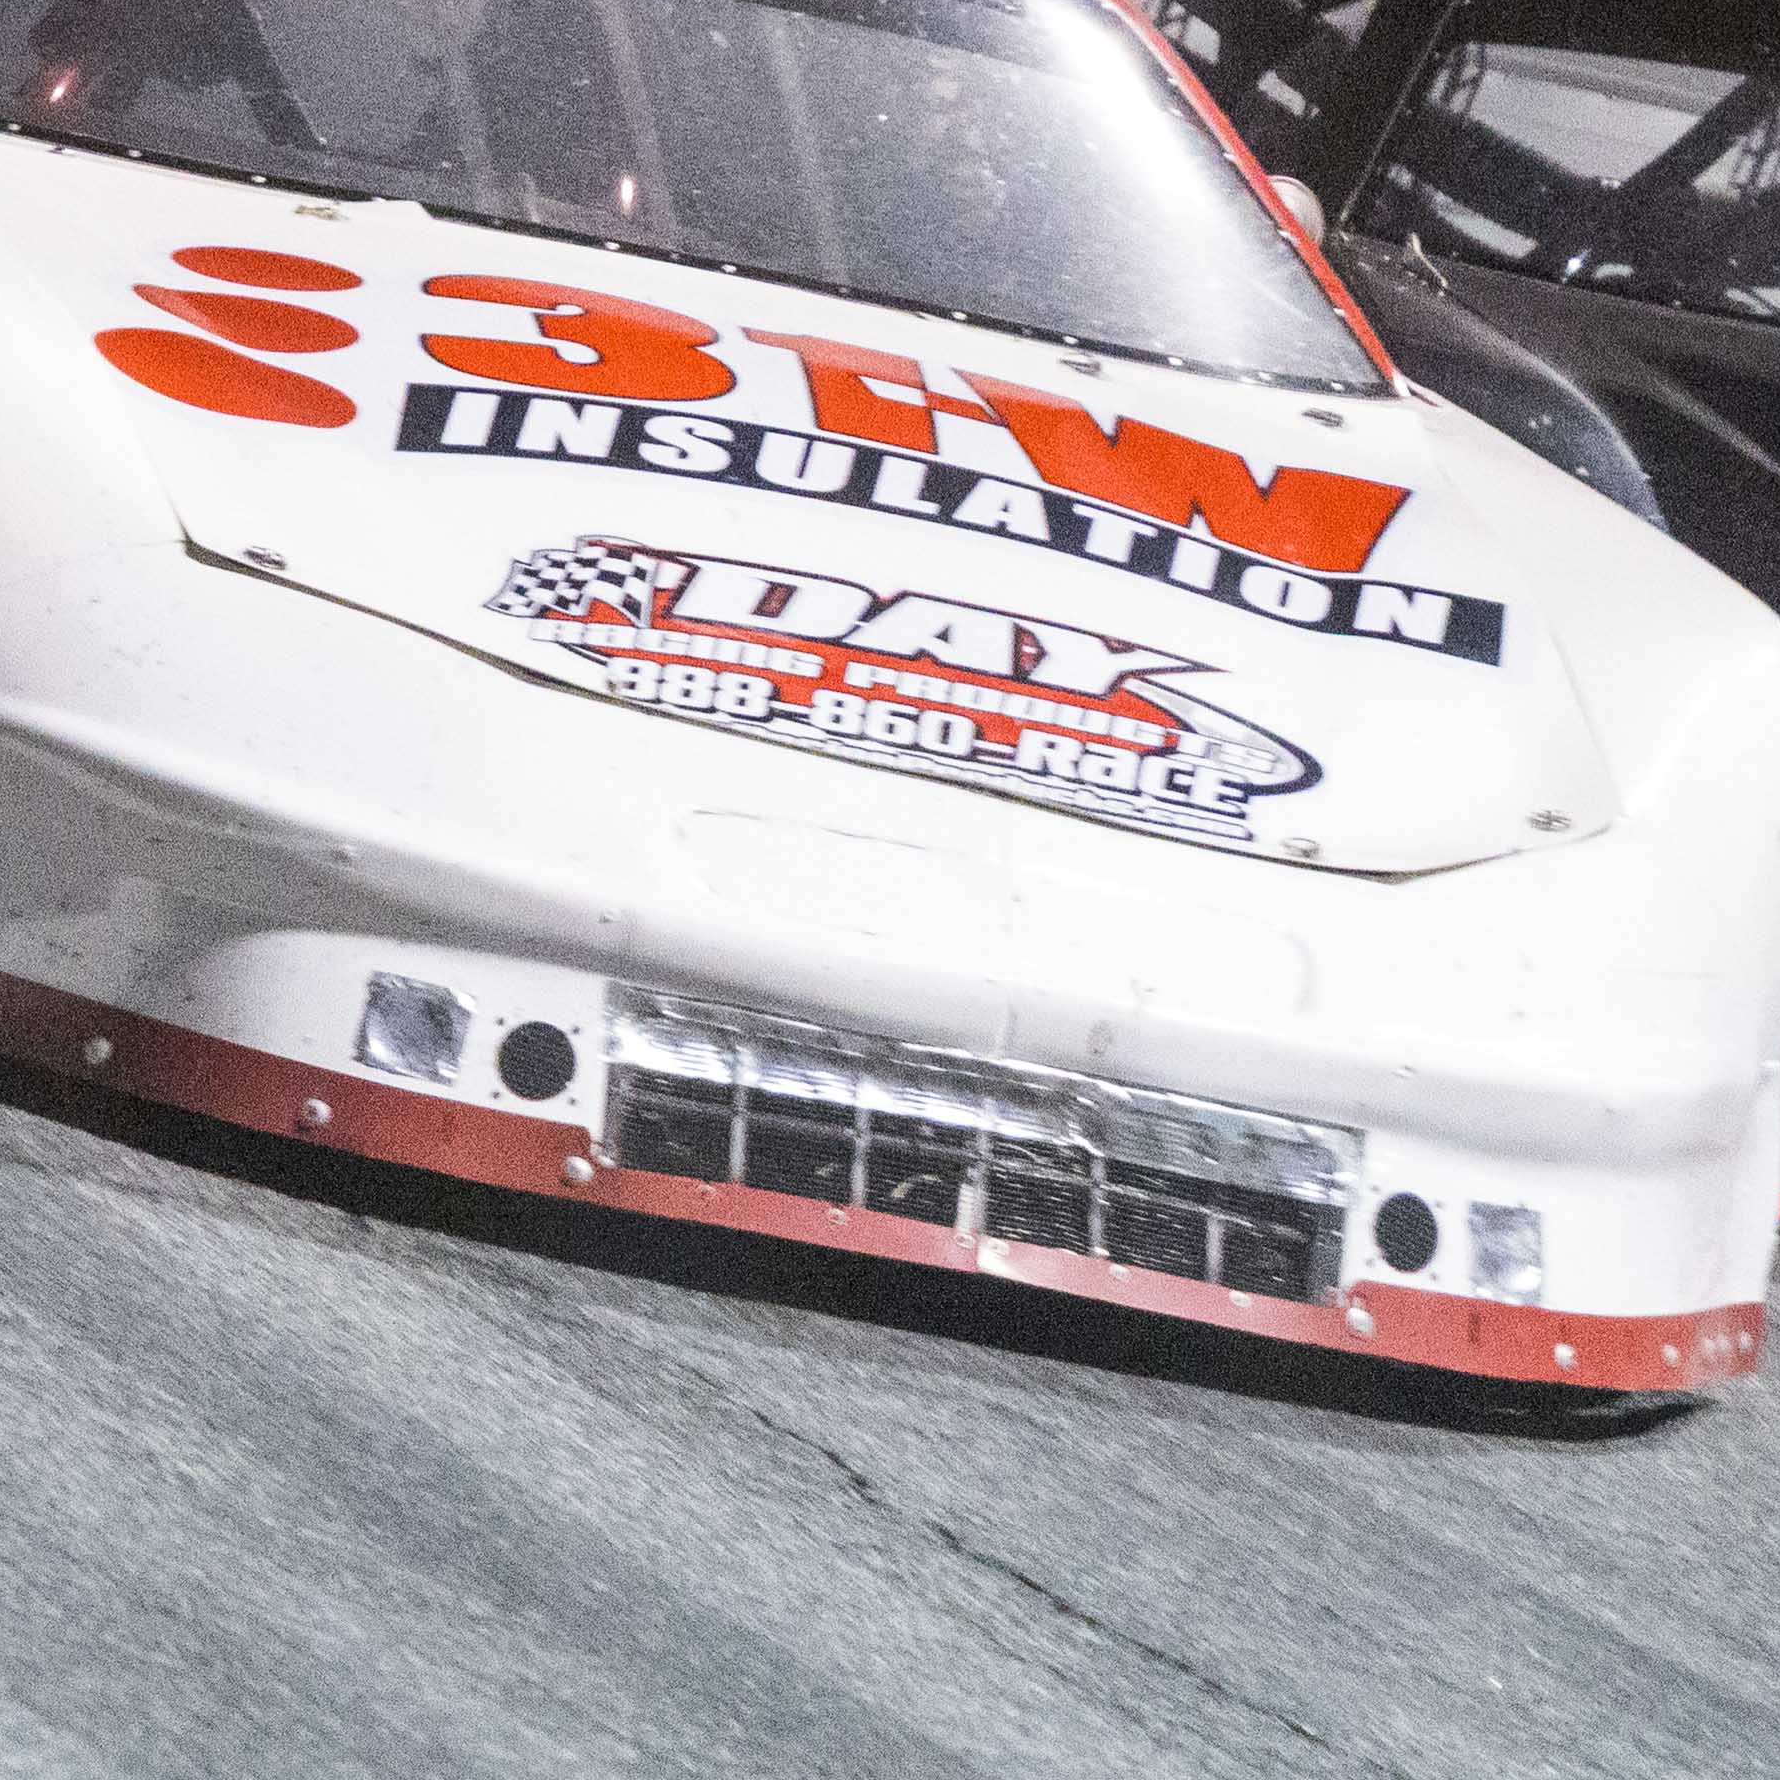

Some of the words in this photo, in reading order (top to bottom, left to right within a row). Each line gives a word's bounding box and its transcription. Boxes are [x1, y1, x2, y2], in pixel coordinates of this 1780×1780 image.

[439, 388, 1453, 648] INSULATION
[669, 560, 1216, 698] DAY
[842, 660, 1281, 776] PRODUCTS
